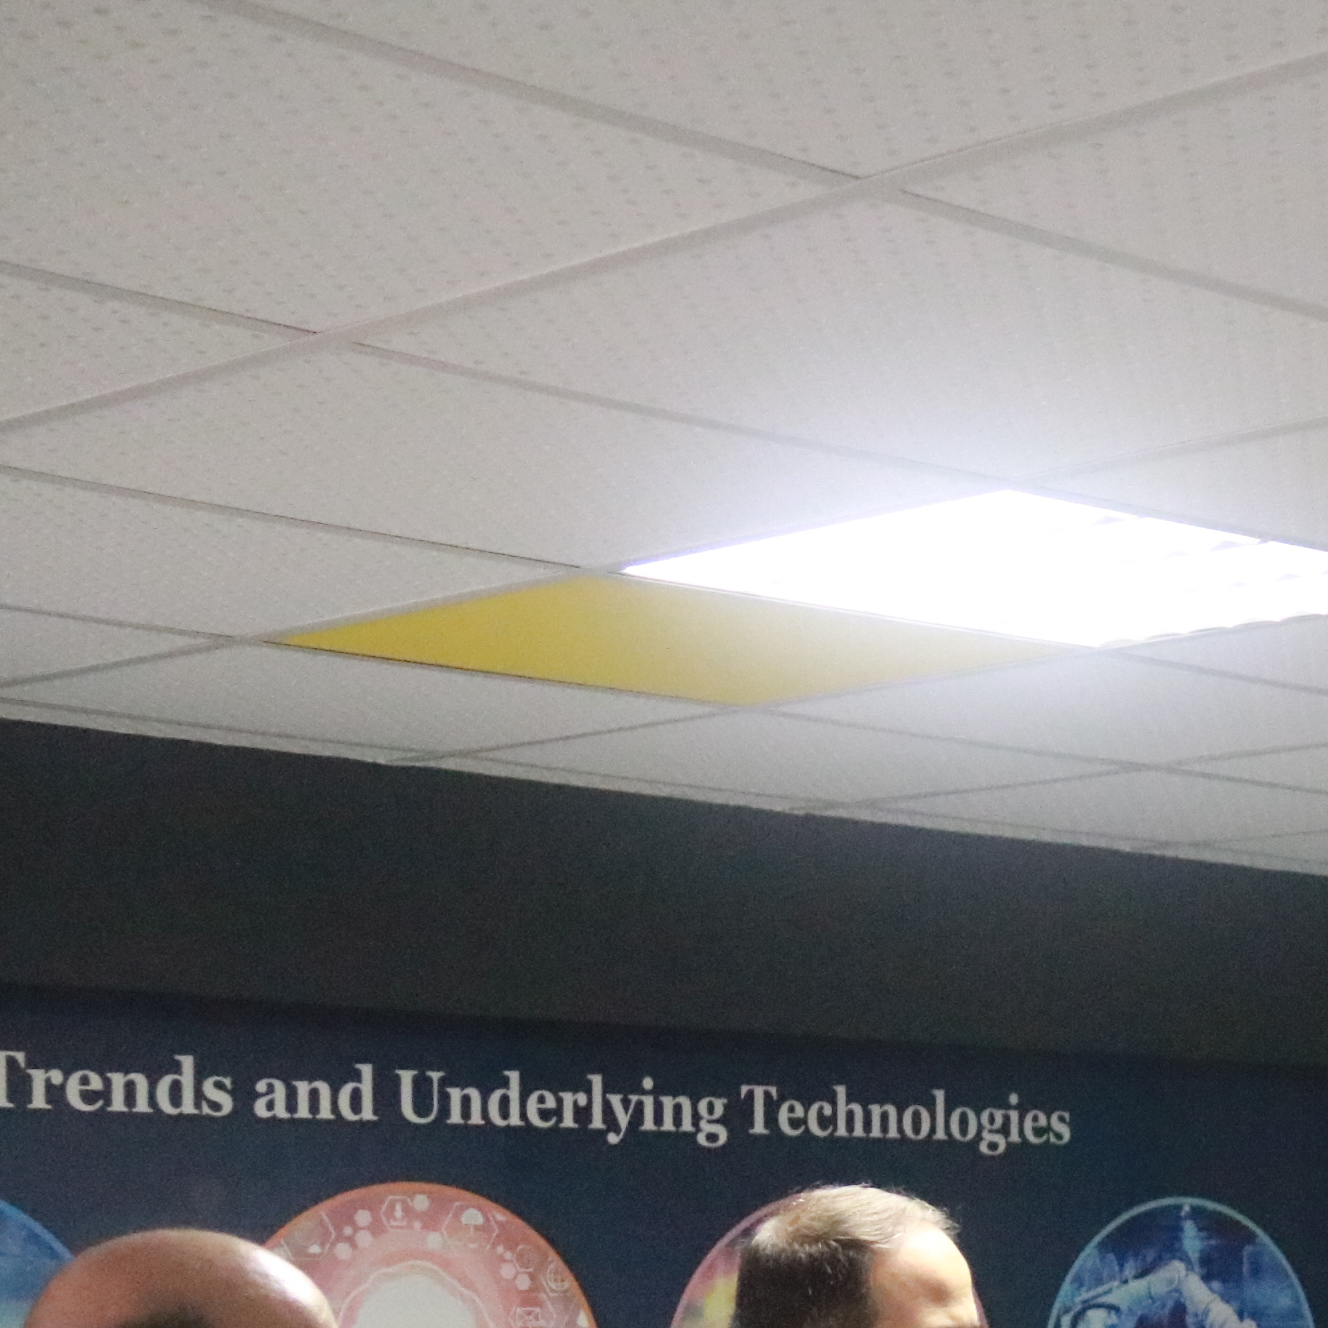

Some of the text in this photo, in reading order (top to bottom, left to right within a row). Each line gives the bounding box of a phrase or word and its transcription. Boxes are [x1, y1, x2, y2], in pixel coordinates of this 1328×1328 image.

[0, 1049, 1071, 1155] Trends and Underlying Technologies
